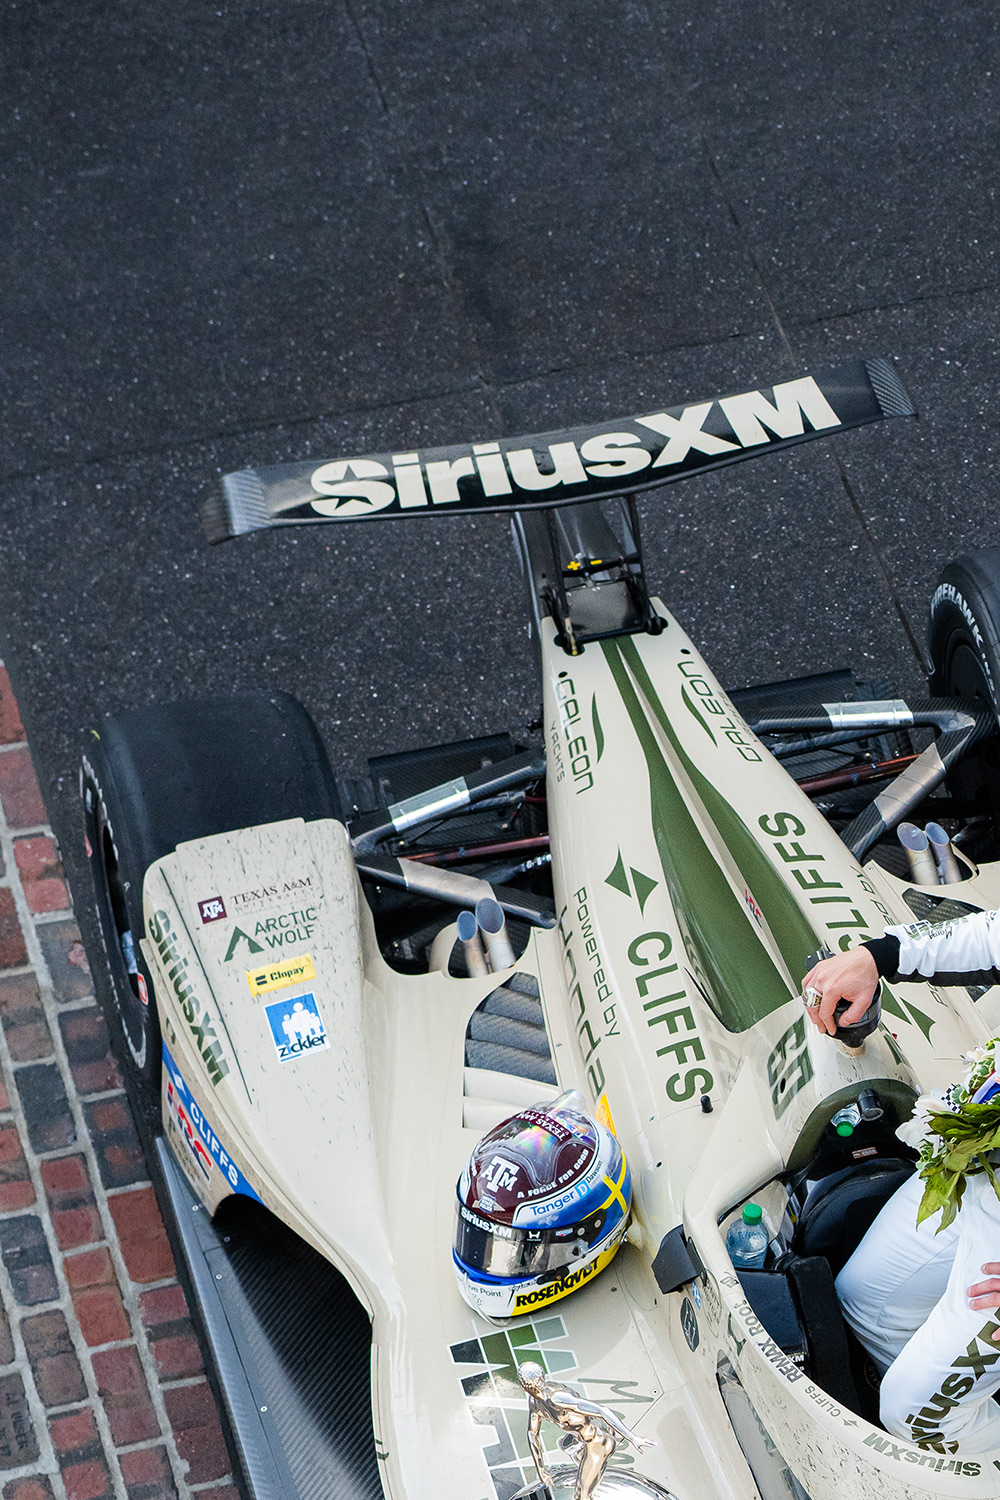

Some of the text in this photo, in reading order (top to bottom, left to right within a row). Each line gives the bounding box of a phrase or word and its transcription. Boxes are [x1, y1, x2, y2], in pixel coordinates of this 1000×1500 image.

[310, 376, 842, 517] SiriusXM
[677, 661, 763, 762] GALEON
[550, 720, 566, 783] YACHTS
[556, 679, 594, 795] GALEON
[231, 877, 313, 905] TEXAS A&M
[254, 907, 318, 937] ARCTIC
[265, 925, 315, 949] WOLF
[270, 966, 306, 982] Clopay
[573, 886, 621, 1037] Powered by
[148, 908, 231, 1088] SiriusXM
[558, 905, 606, 1099] Honda
[627, 931, 714, 1103] CLIFFS
[189, 1101, 239, 1187] CLIFFS
[534, 1117, 568, 1142] TEXAS
[517, 1149, 590, 1199] A FORCE FOR GOOD
[586, 1160, 604, 1184] Dawson
[460, 1207, 513, 1239] SiriusXM
[530, 1190, 575, 1216] Tanger
[480, 1287, 502, 1298] Point
[515, 1255, 601, 1307] ROSENQVIST
[804, 1385, 842, 1418] CLIFFS
[864, 1431, 983, 1479] SiriusXM
